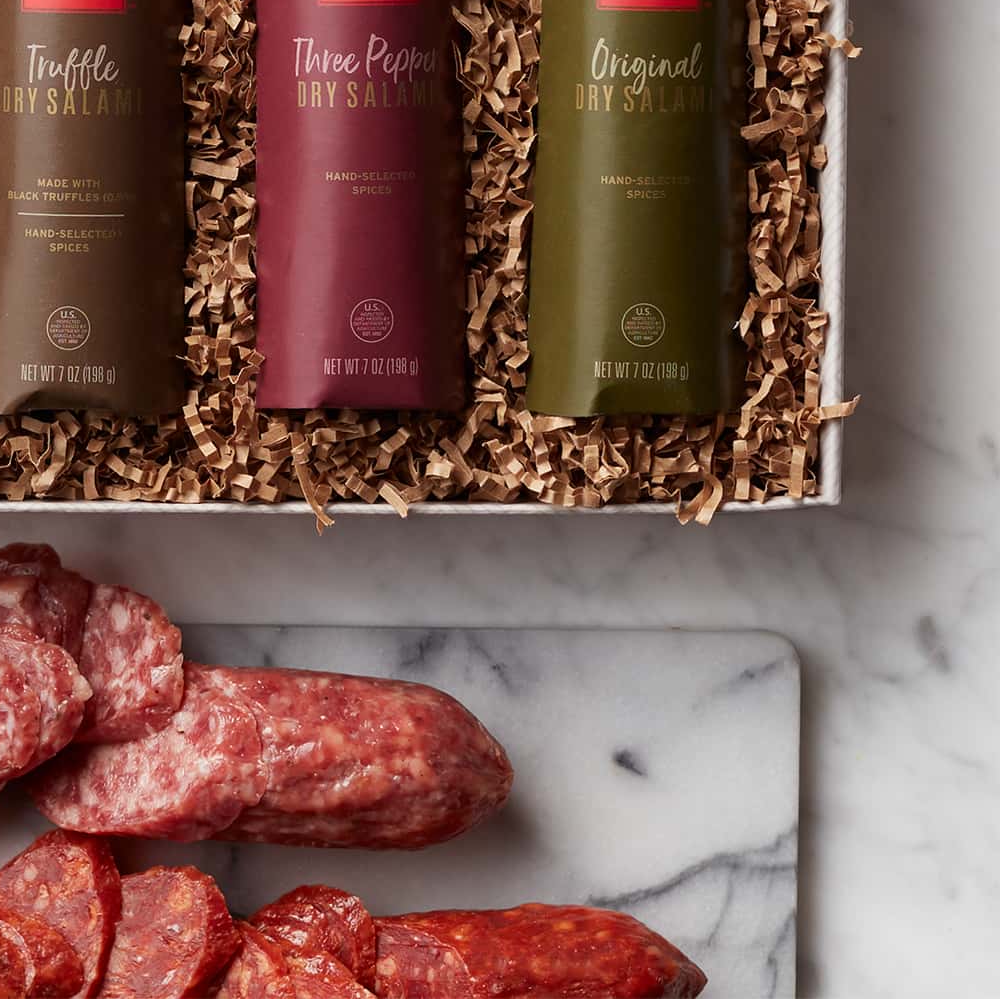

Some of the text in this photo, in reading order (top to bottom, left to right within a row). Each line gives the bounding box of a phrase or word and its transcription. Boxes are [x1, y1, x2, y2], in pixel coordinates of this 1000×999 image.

[293, 36, 361, 77] Three
[591, 37, 703, 96] Original
[27, 43, 120, 91] Truffle
[2, 86, 143, 115] DRY SALAMI
[297, 81, 337, 108] DRY
[575, 83, 614, 112] DRY
[37, 178, 101, 189] MADE WITH
[352, 185, 392, 195] SPICES
[7, 190, 39, 201] BLACK
[41, 191, 99, 202] TRUFFLES
[626, 189, 666, 199] SPICES
[24, 228, 118, 239] HAND-SELECTED
[49, 243, 90, 253] SPICES
[20, 363, 38, 382] NET
[40, 364, 56, 382] WT
[58, 365, 65, 382] 7
[67, 366, 81, 383] OZ
[83, 365, 104, 385] (198
[323, 357, 342, 375] NET
[344, 357, 360, 375] WT
[361, 358, 368, 375] 7
[371, 358, 384, 375] OZ
[386, 357, 407, 377] (198
[594, 361, 613, 379] NET
[615, 361, 631, 379] WT
[633, 362, 640, 379] 7
[642, 362, 655, 380] OZ
[656, 361, 678, 380] (198
